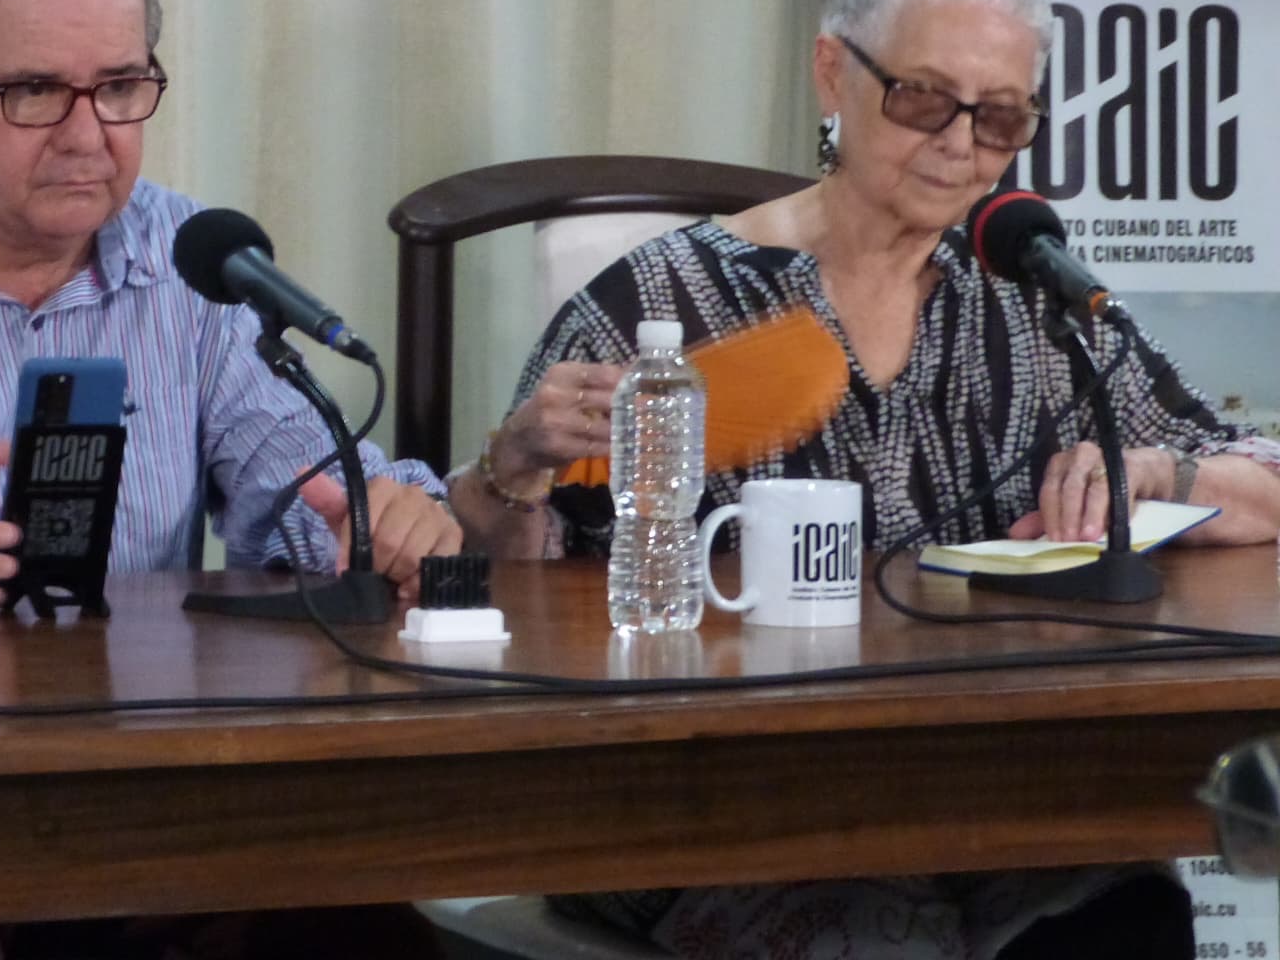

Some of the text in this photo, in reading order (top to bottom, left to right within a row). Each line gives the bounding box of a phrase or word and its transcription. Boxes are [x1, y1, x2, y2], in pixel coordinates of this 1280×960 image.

[1093, 219, 1160, 237] CUBANO
[1165, 219, 1193, 237] DEL
[1198, 219, 1237, 237] ARTE
[1093, 241, 1255, 263] CINEMATOGRÁFICOS
